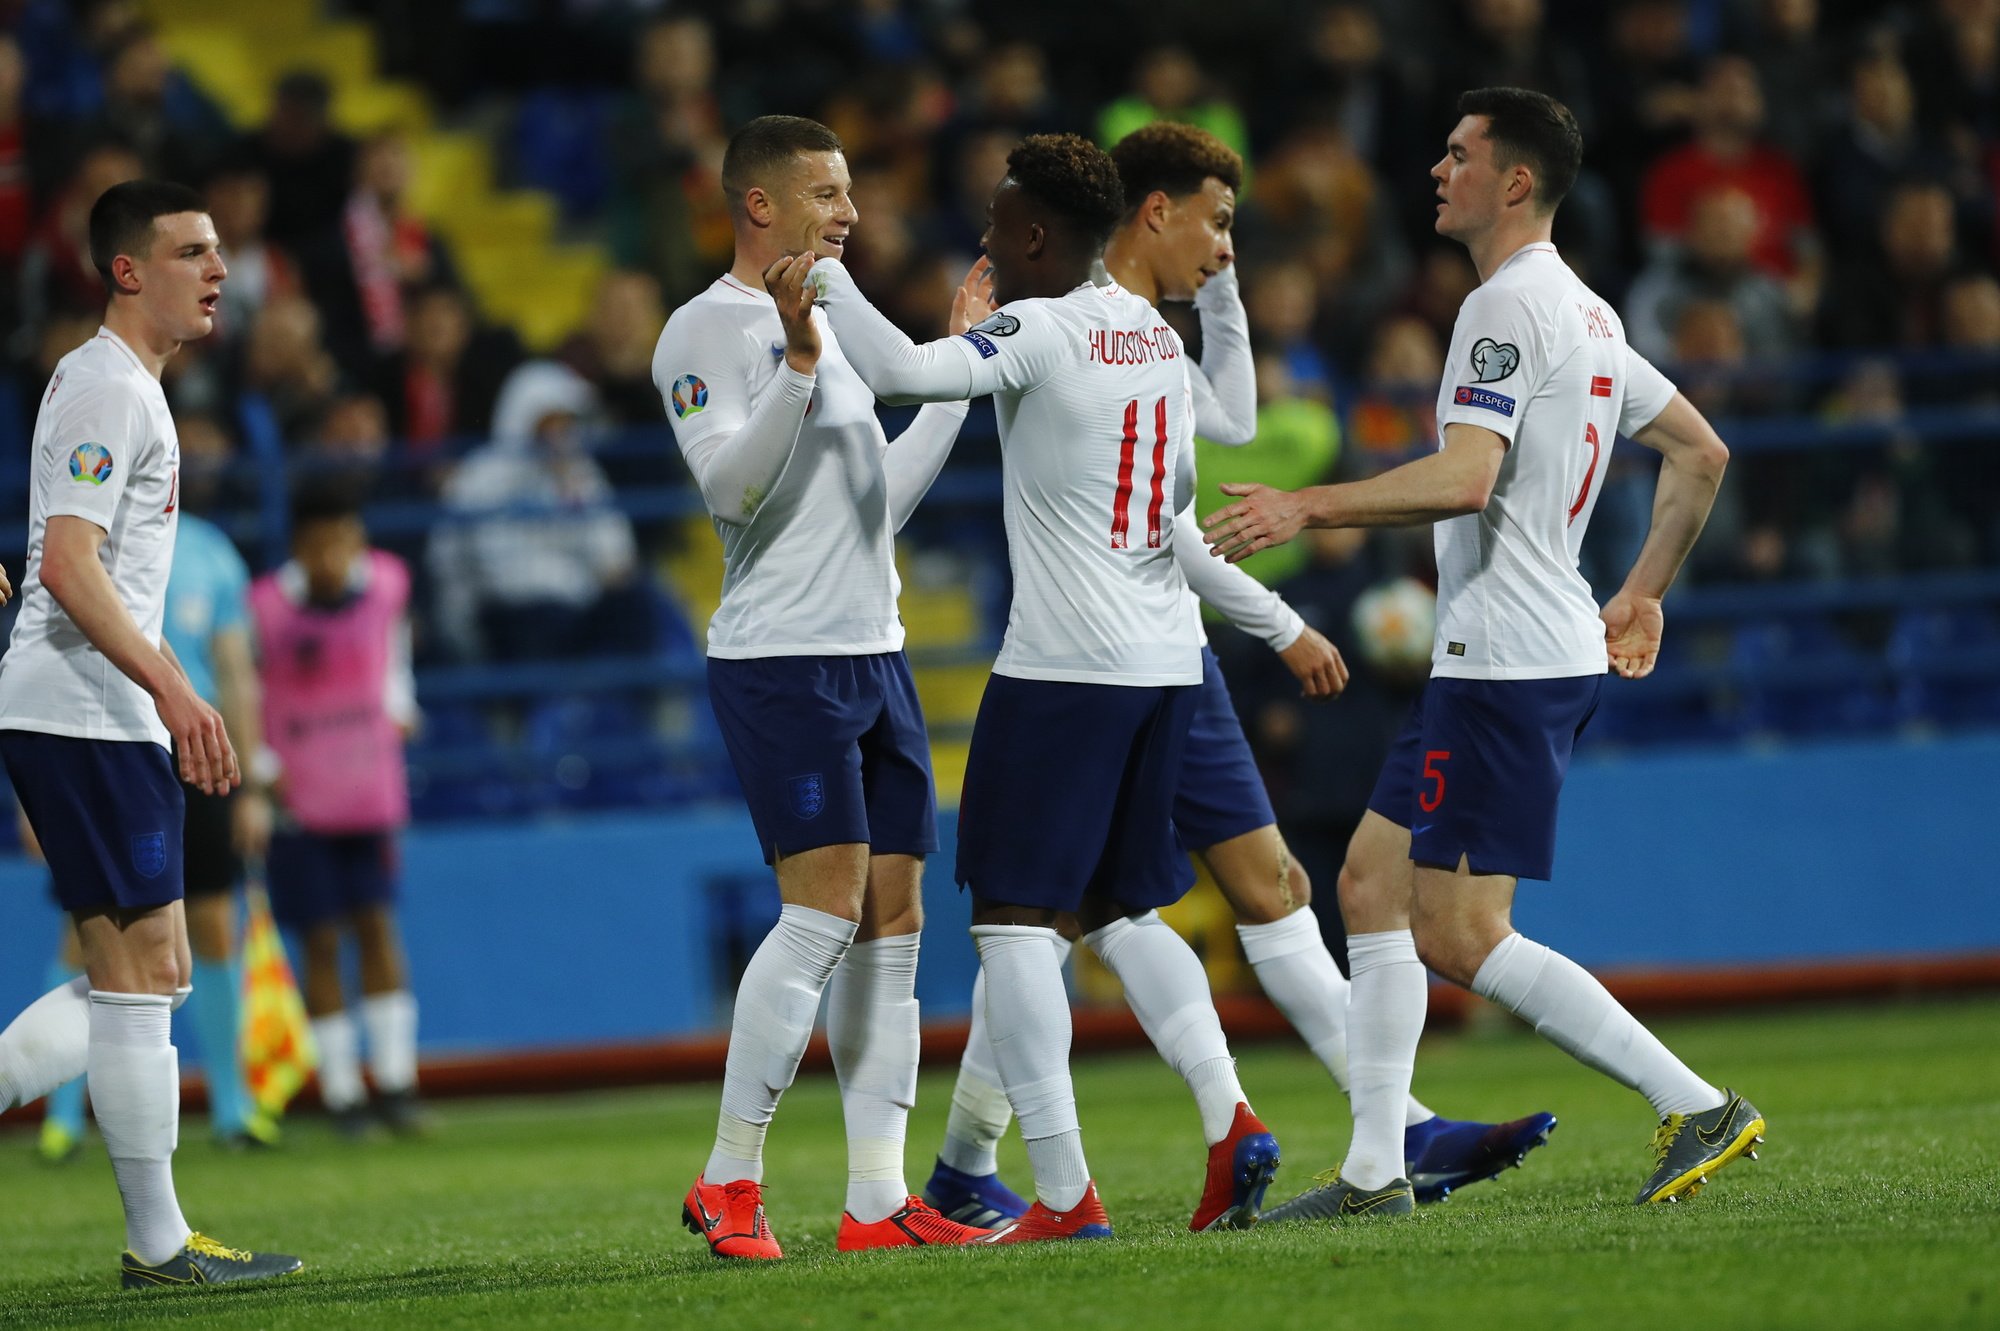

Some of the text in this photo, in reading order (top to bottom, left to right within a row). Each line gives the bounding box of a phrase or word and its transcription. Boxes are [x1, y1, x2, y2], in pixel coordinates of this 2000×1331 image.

[1472, 393, 1515, 412] RESPECT
[1110, 395, 1168, 549] 11
[1419, 750, 1451, 813] 5
